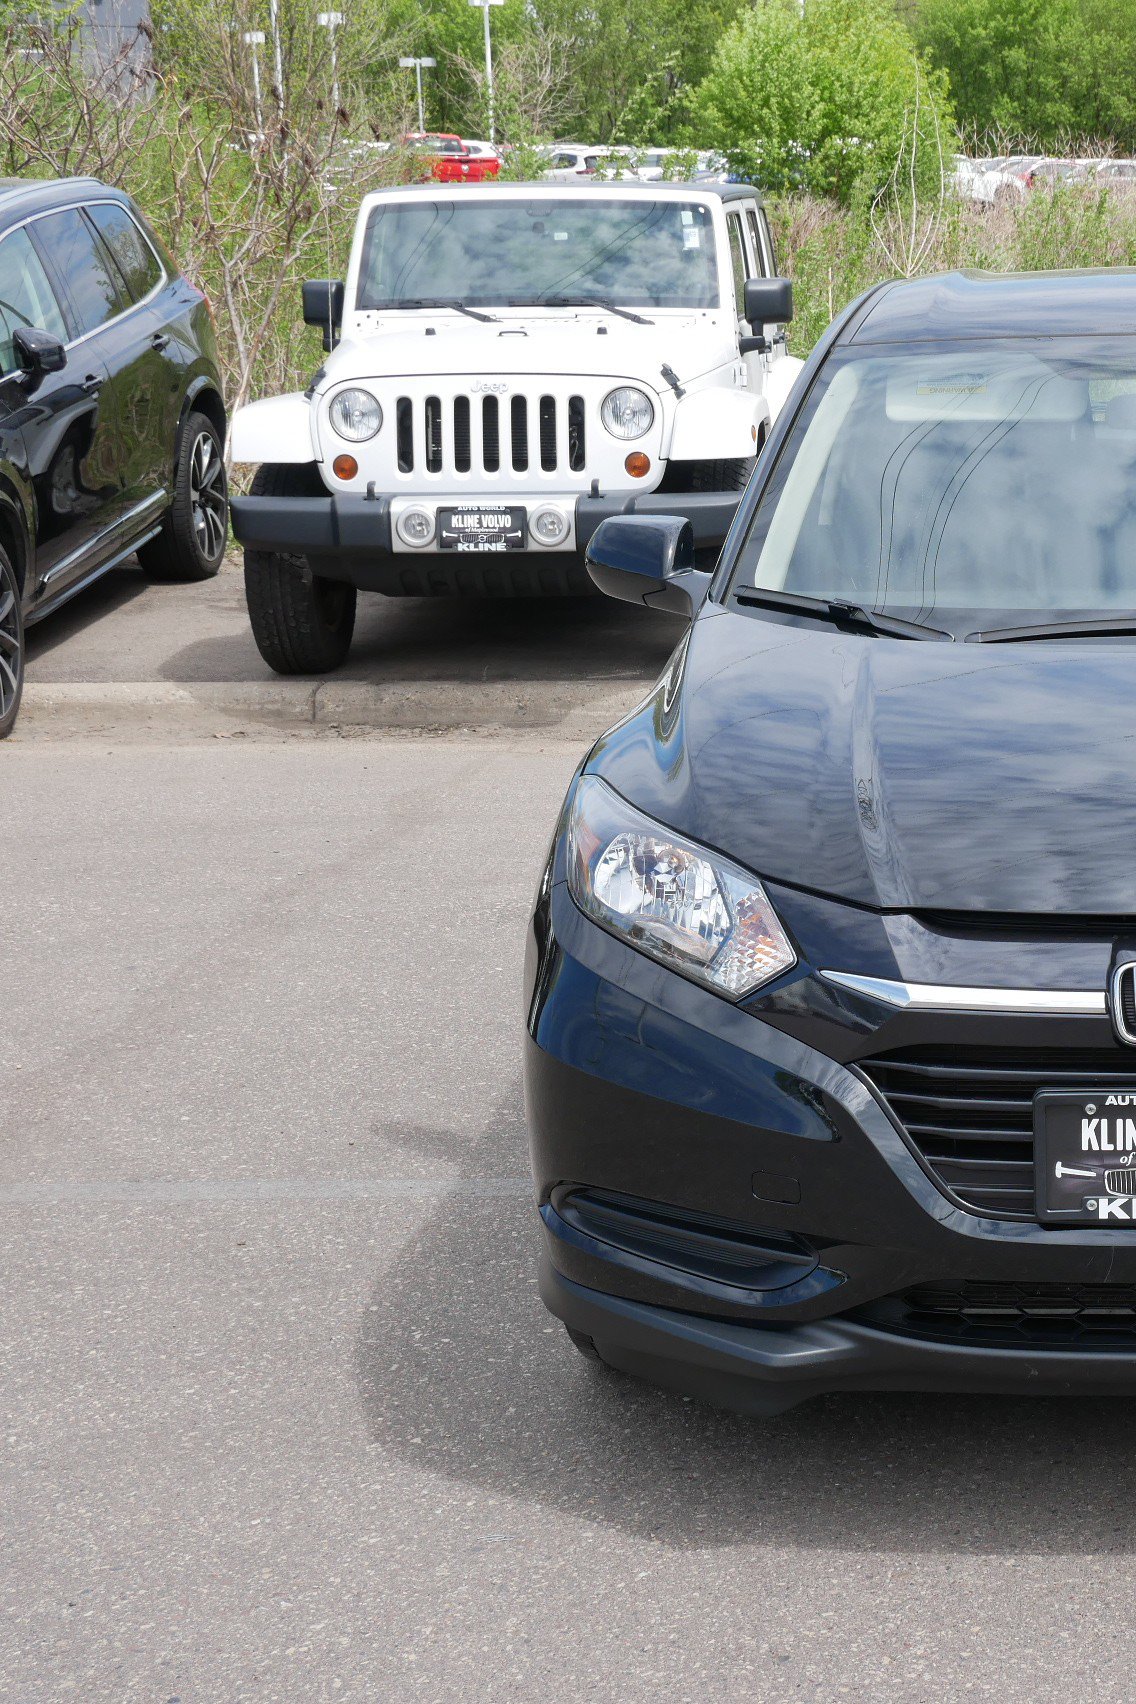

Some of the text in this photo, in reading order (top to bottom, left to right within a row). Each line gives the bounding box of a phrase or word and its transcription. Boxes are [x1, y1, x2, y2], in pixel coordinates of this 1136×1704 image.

[470, 380, 509, 394] Jeep
[451, 514, 512, 528] KLINE VOLVO
[457, 543, 507, 551] KLINE
[1119, 1152, 1136, 1166] of
